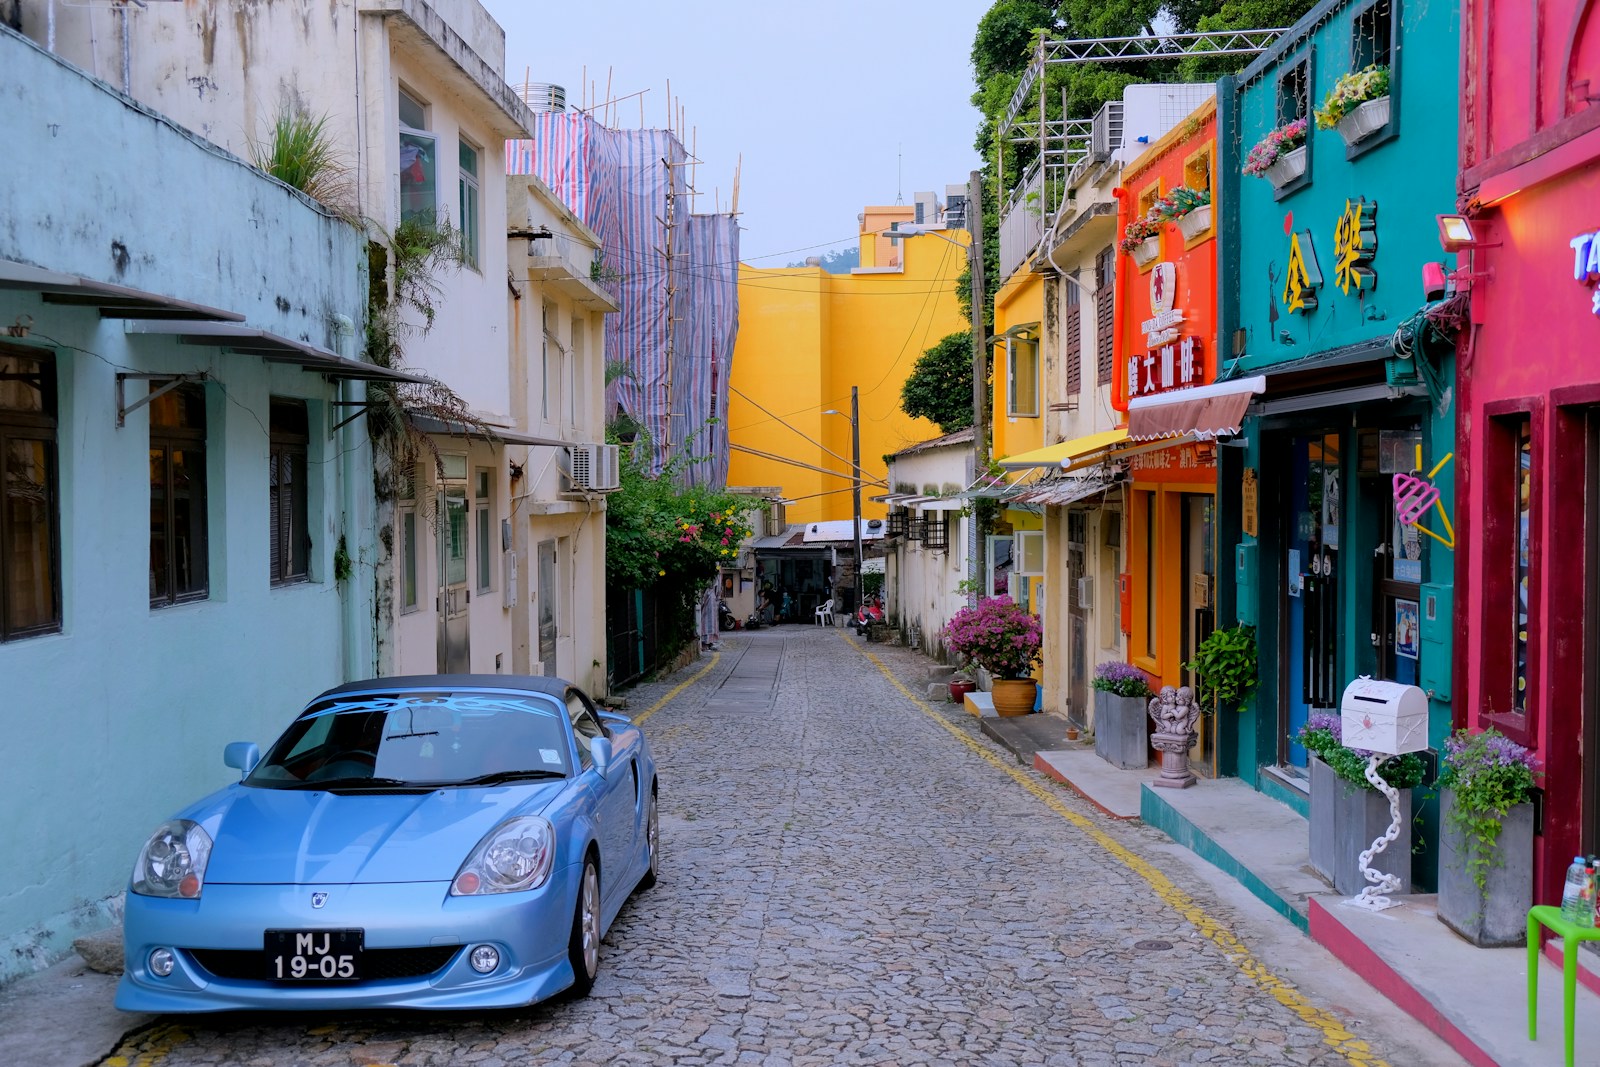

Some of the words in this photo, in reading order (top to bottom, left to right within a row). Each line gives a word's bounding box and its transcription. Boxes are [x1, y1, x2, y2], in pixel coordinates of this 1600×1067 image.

[1128, 336, 1194, 396] 蜂大咖啡
[296, 933, 330, 955] MJ
[275, 955, 354, 978] 19-05
